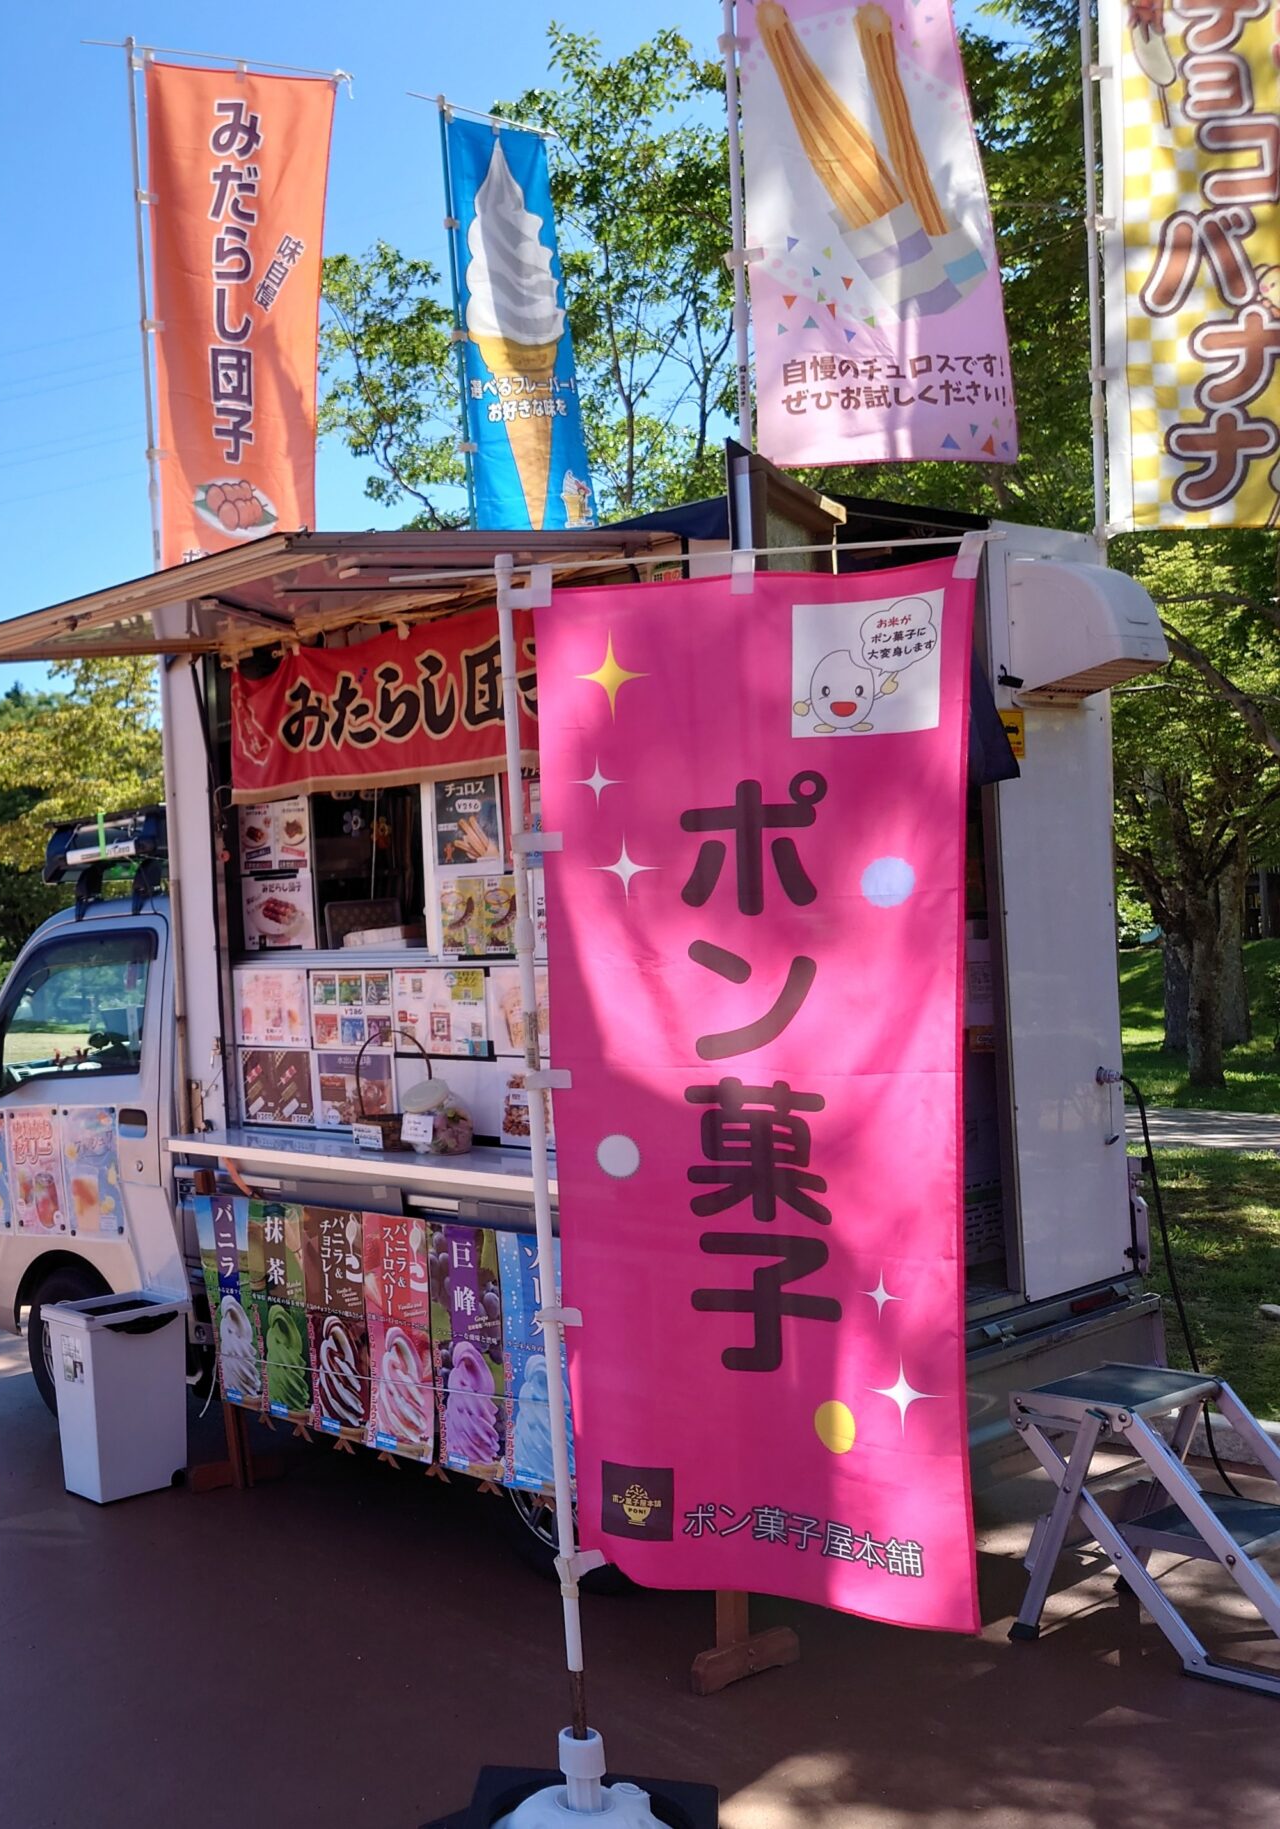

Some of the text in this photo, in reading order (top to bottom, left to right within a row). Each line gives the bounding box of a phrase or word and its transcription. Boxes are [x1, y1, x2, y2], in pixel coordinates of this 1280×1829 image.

[208, 99, 263, 463] みだらし団子
[253, 235, 304, 312] 味自慢
[488, 399, 568, 423] お好きな味を
[867, 640, 934, 661] 大変身します
[871, 627, 926, 645] ポン菓子に
[876, 614, 912, 629] お米が
[445, 781, 485, 797] チュロス
[680, 770, 842, 1372] ポン菓子
[214, 1205, 236, 1278] バニラ
[264, 1215, 286, 1286] 抹茶
[320, 1220, 333, 1305] チョコレート
[382, 1226, 396, 1316] ストロベリー
[451, 1240, 477, 1317] 巨峰
[683, 1503, 924, 1578] ポン菓子屋本舗
